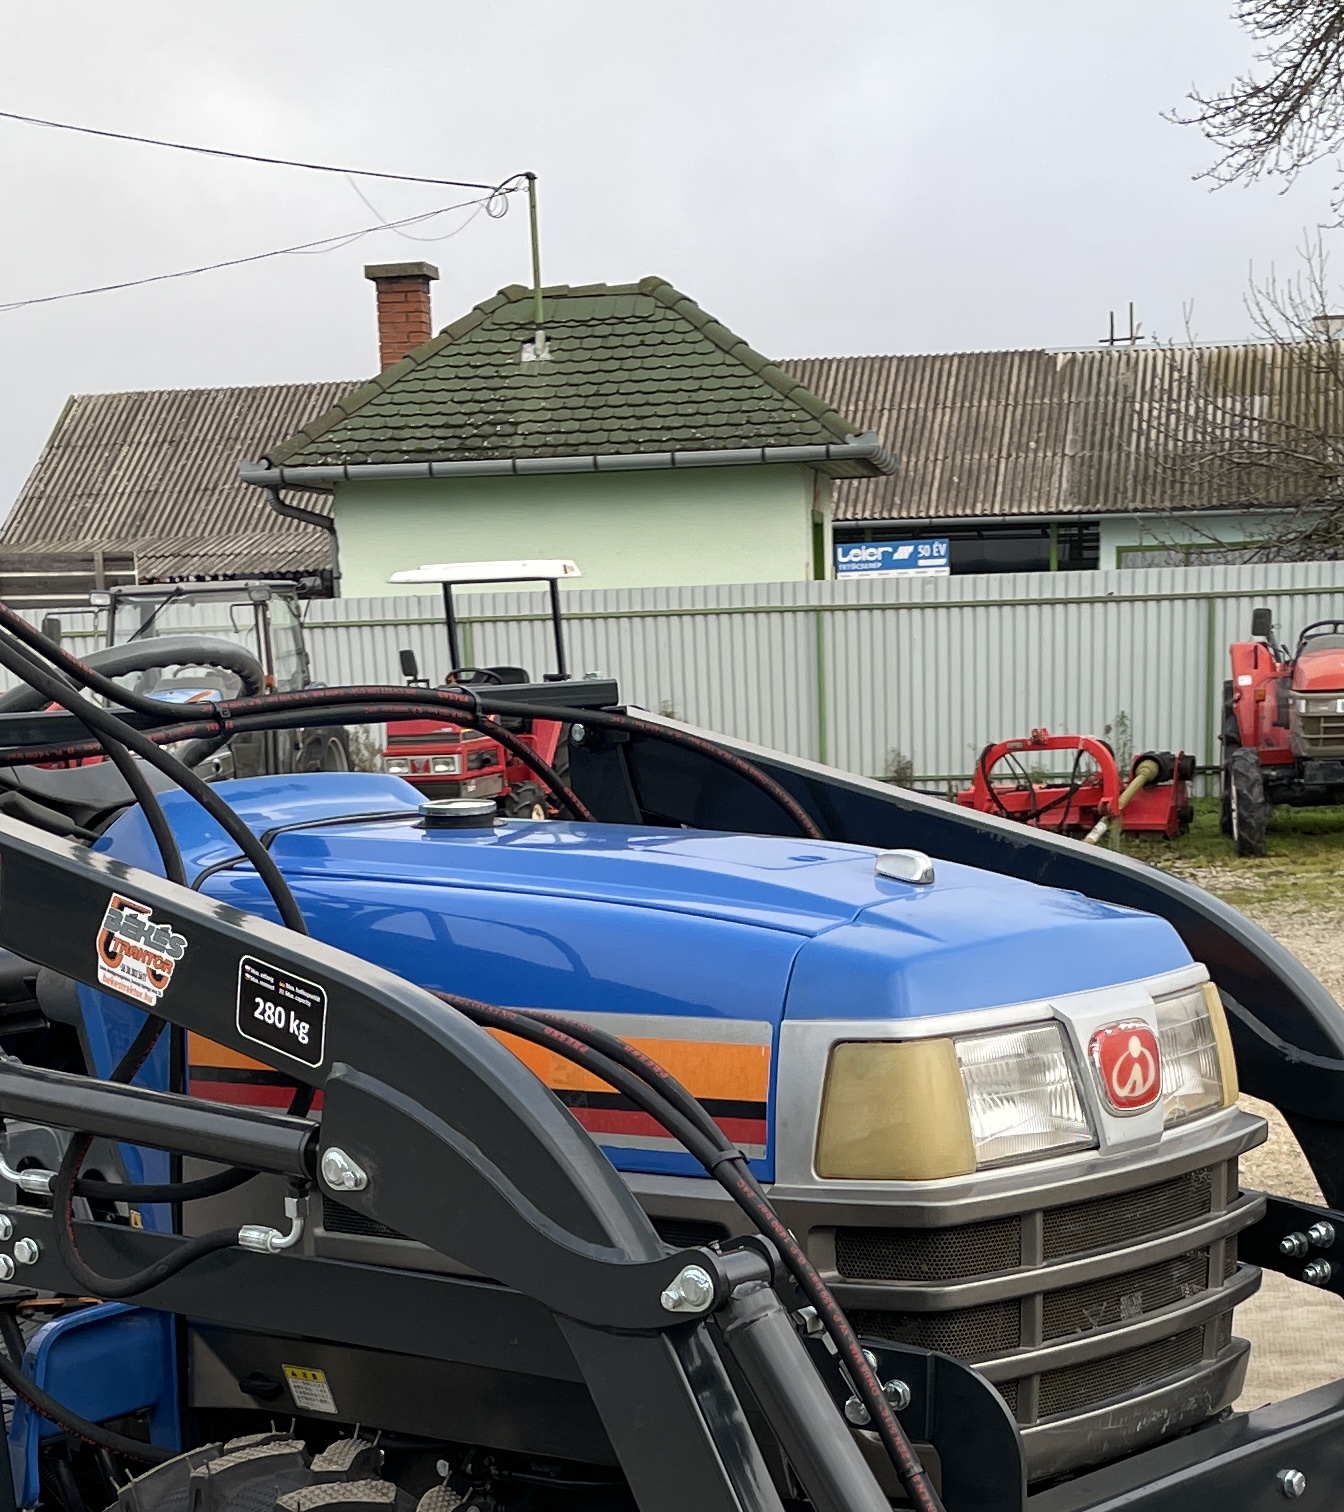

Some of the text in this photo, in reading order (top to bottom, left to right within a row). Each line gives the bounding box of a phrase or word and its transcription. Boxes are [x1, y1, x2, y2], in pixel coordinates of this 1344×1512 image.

[837, 546, 893, 562] Leier
[104, 907, 187, 961] BÉKÉS
[112, 937, 175, 974] TRAKTOR
[254, 997, 310, 1044] 280 kg
